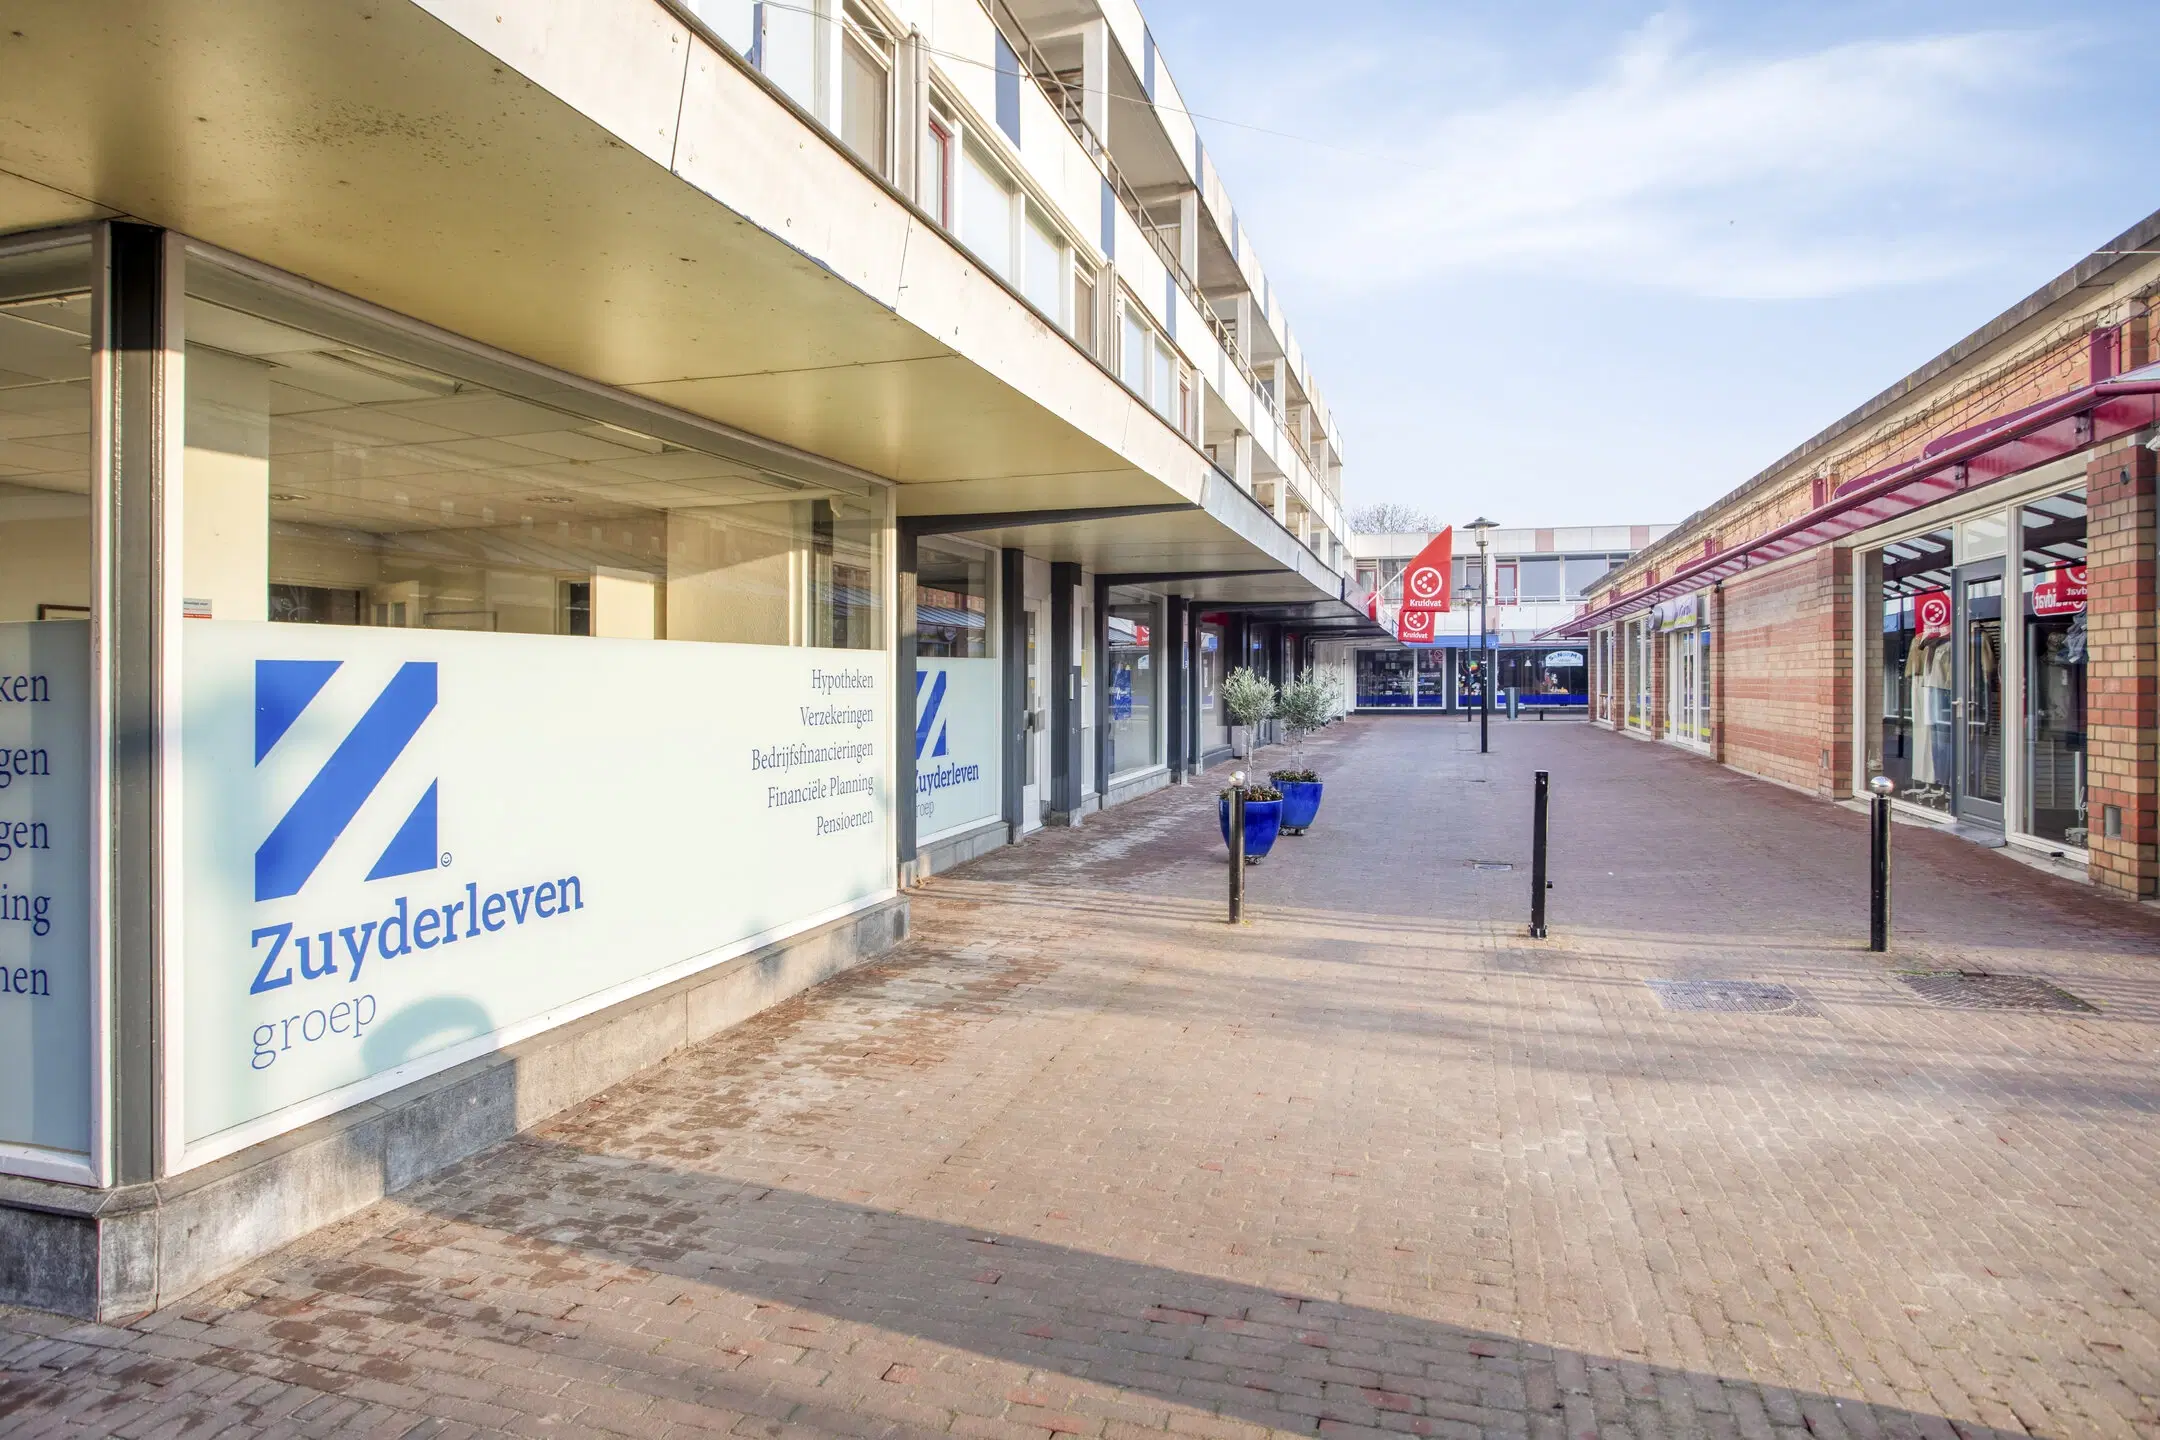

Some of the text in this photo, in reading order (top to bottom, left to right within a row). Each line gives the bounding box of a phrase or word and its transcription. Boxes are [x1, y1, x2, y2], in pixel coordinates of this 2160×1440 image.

[1409, 599, 1442, 607] Kruidvat
[811, 668, 874, 695] Hypotheken
[800, 704, 873, 729] Verzekeringen
[752, 740, 873, 773] Bedrijfsfinancieringen
[767, 774, 874, 808] Financiële Planning
[816, 809, 874, 836] Pensioenen
[250, 875, 584, 995] Zuyderleven
[251, 994, 377, 1070] groep
